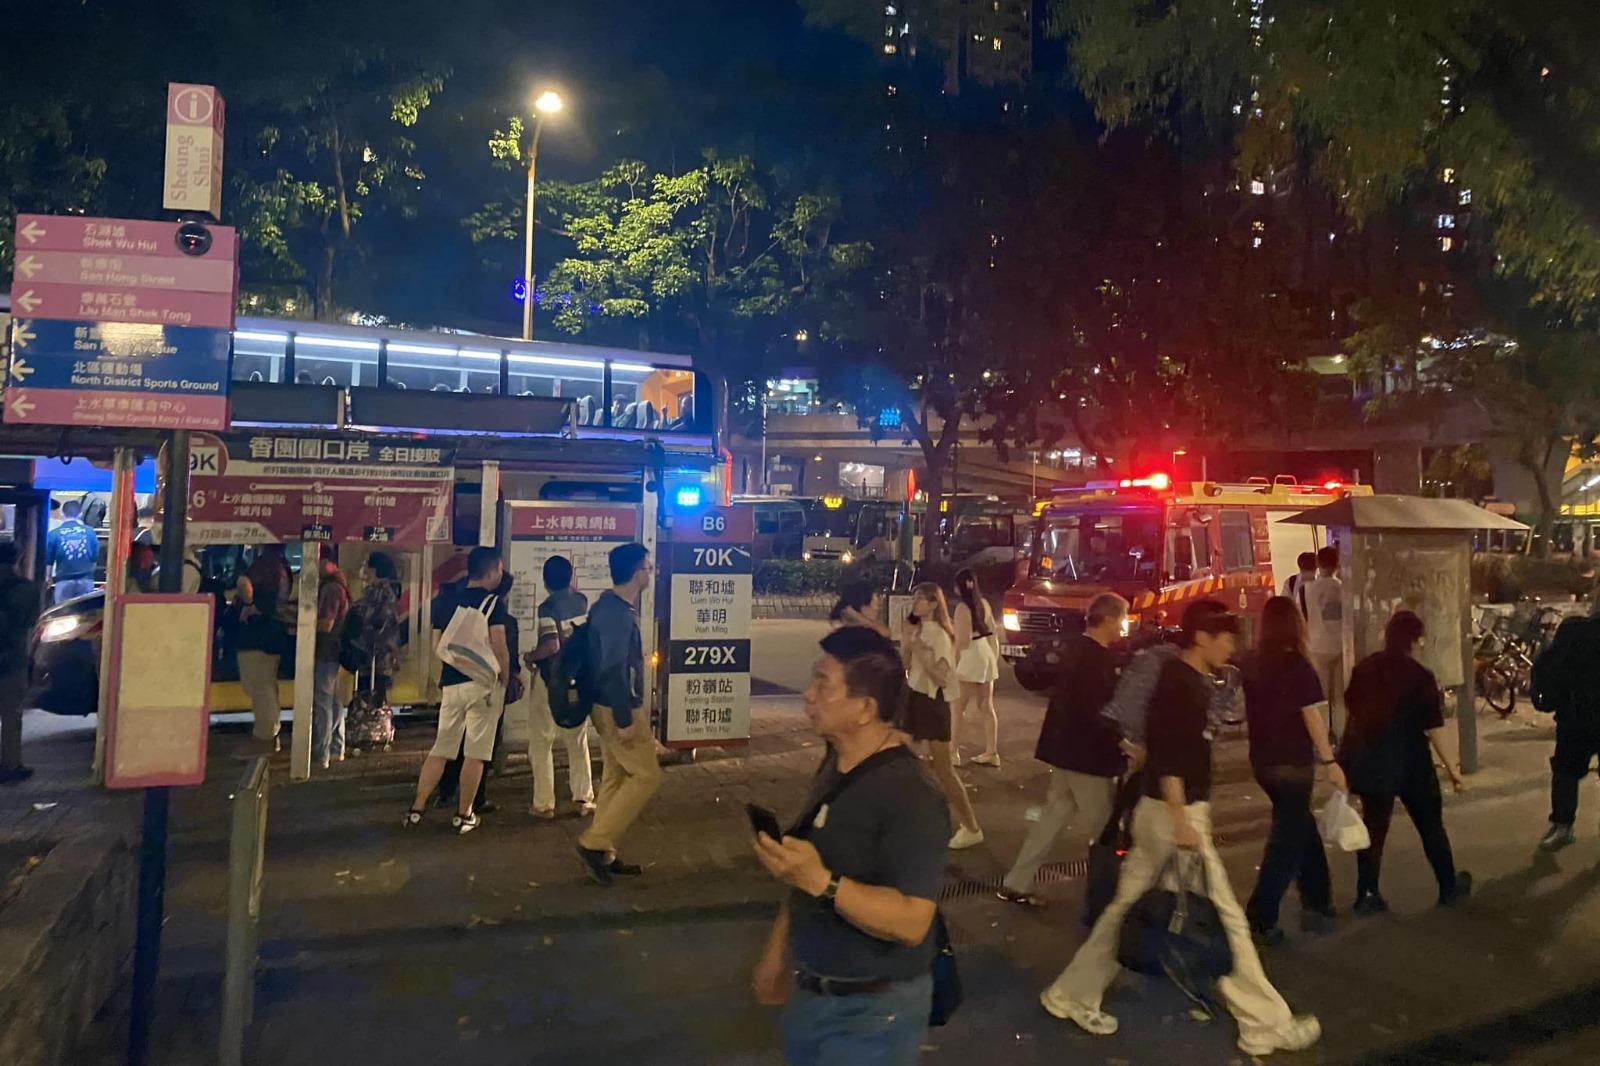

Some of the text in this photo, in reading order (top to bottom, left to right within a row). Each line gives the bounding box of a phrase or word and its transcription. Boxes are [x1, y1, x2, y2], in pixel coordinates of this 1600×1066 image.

[171, 134, 194, 201] Sheung
[194, 146, 210, 187] Shui
[115, 239, 135, 249] Wu
[138, 240, 157, 250] Hui
[162, 309, 192, 322] Tong
[74, 340, 97, 350] San
[71, 375, 219, 391] North District Sports Ground
[249, 436, 441, 463] 香園圍口岸 全日接駁
[531, 514, 617, 531] 上水轉乘網絡
[703, 516, 725, 531] B6
[693, 548, 733, 566] 70K
[689, 580, 735, 595] 聯和墟
[696, 608, 726, 623] 華明
[695, 625, 728, 634] Wah Ming
[684, 646, 736, 665] 279X
[687, 678, 733, 694] 粉嶺站
[686, 707, 732, 724] 聯和墟
